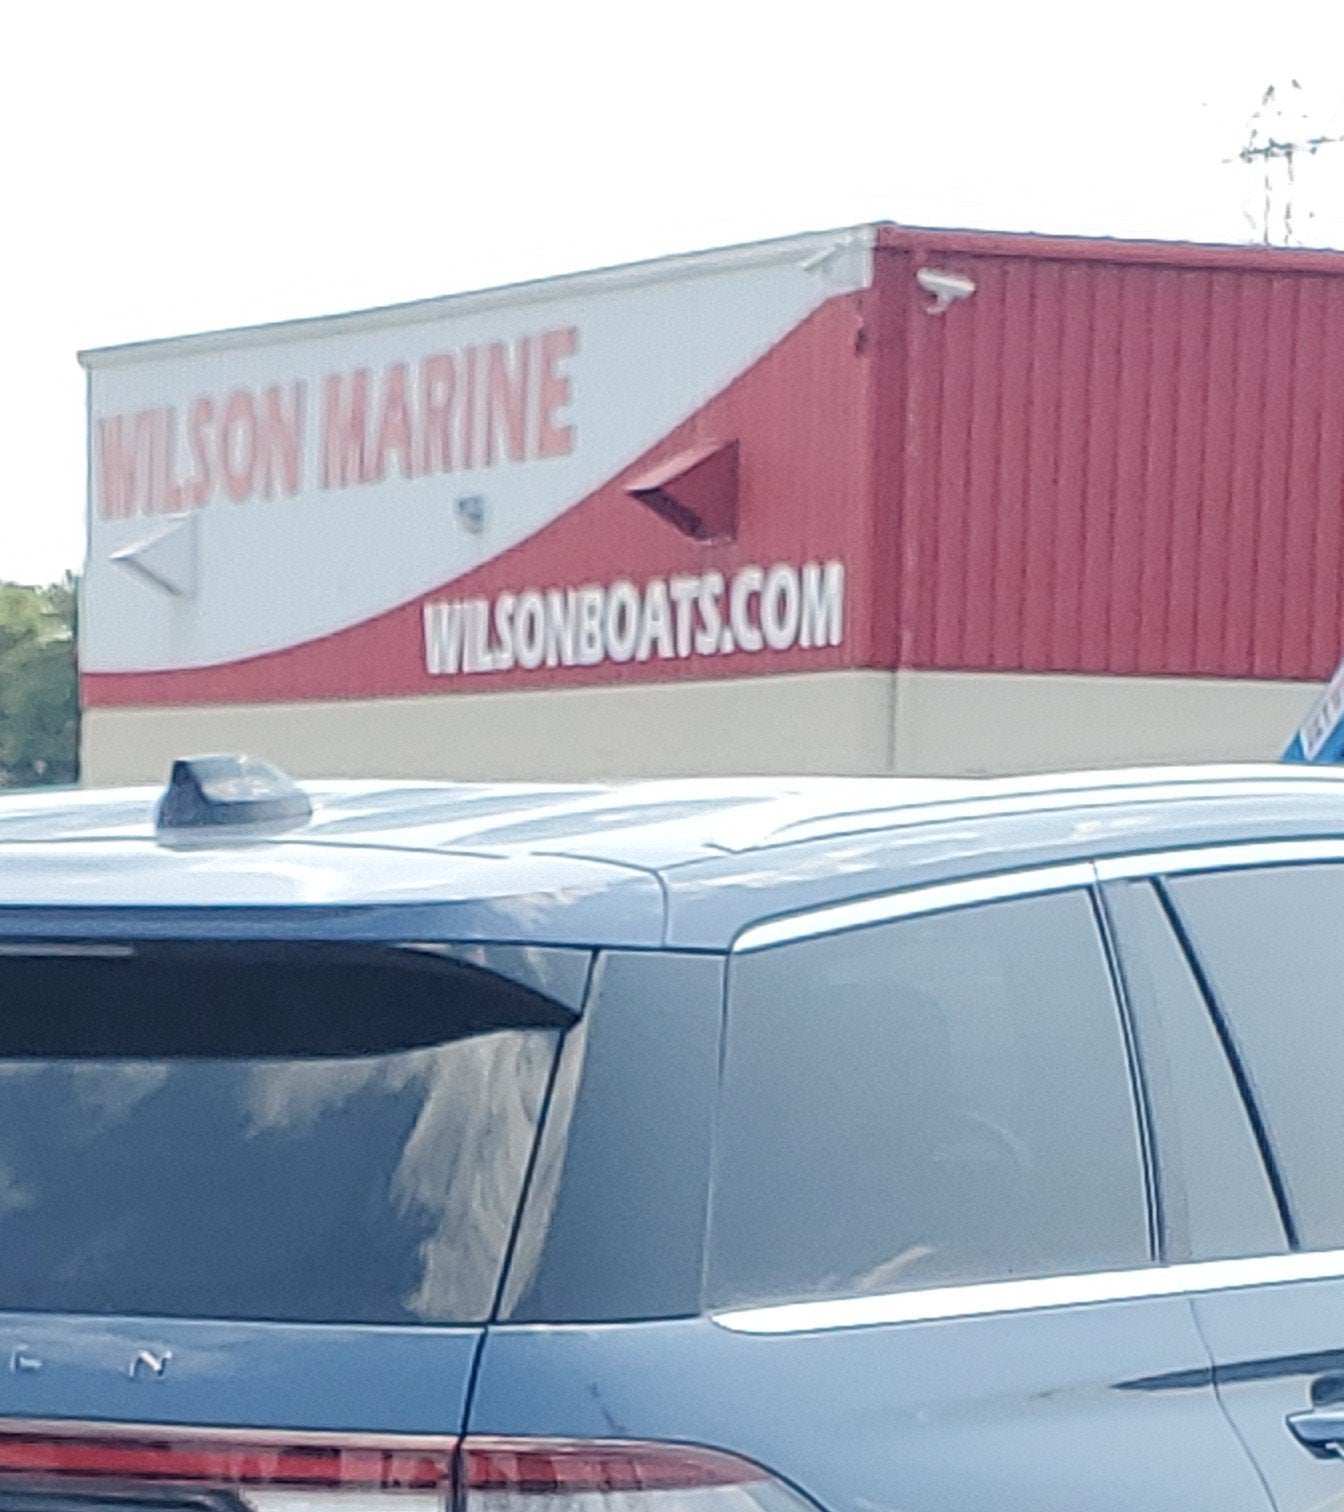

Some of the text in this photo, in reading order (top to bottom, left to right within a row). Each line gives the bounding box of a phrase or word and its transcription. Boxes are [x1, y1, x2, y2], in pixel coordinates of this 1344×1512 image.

[96, 325, 581, 520] WILSON MARINE
[423, 560, 846, 676] WILSONBOATS.COM
